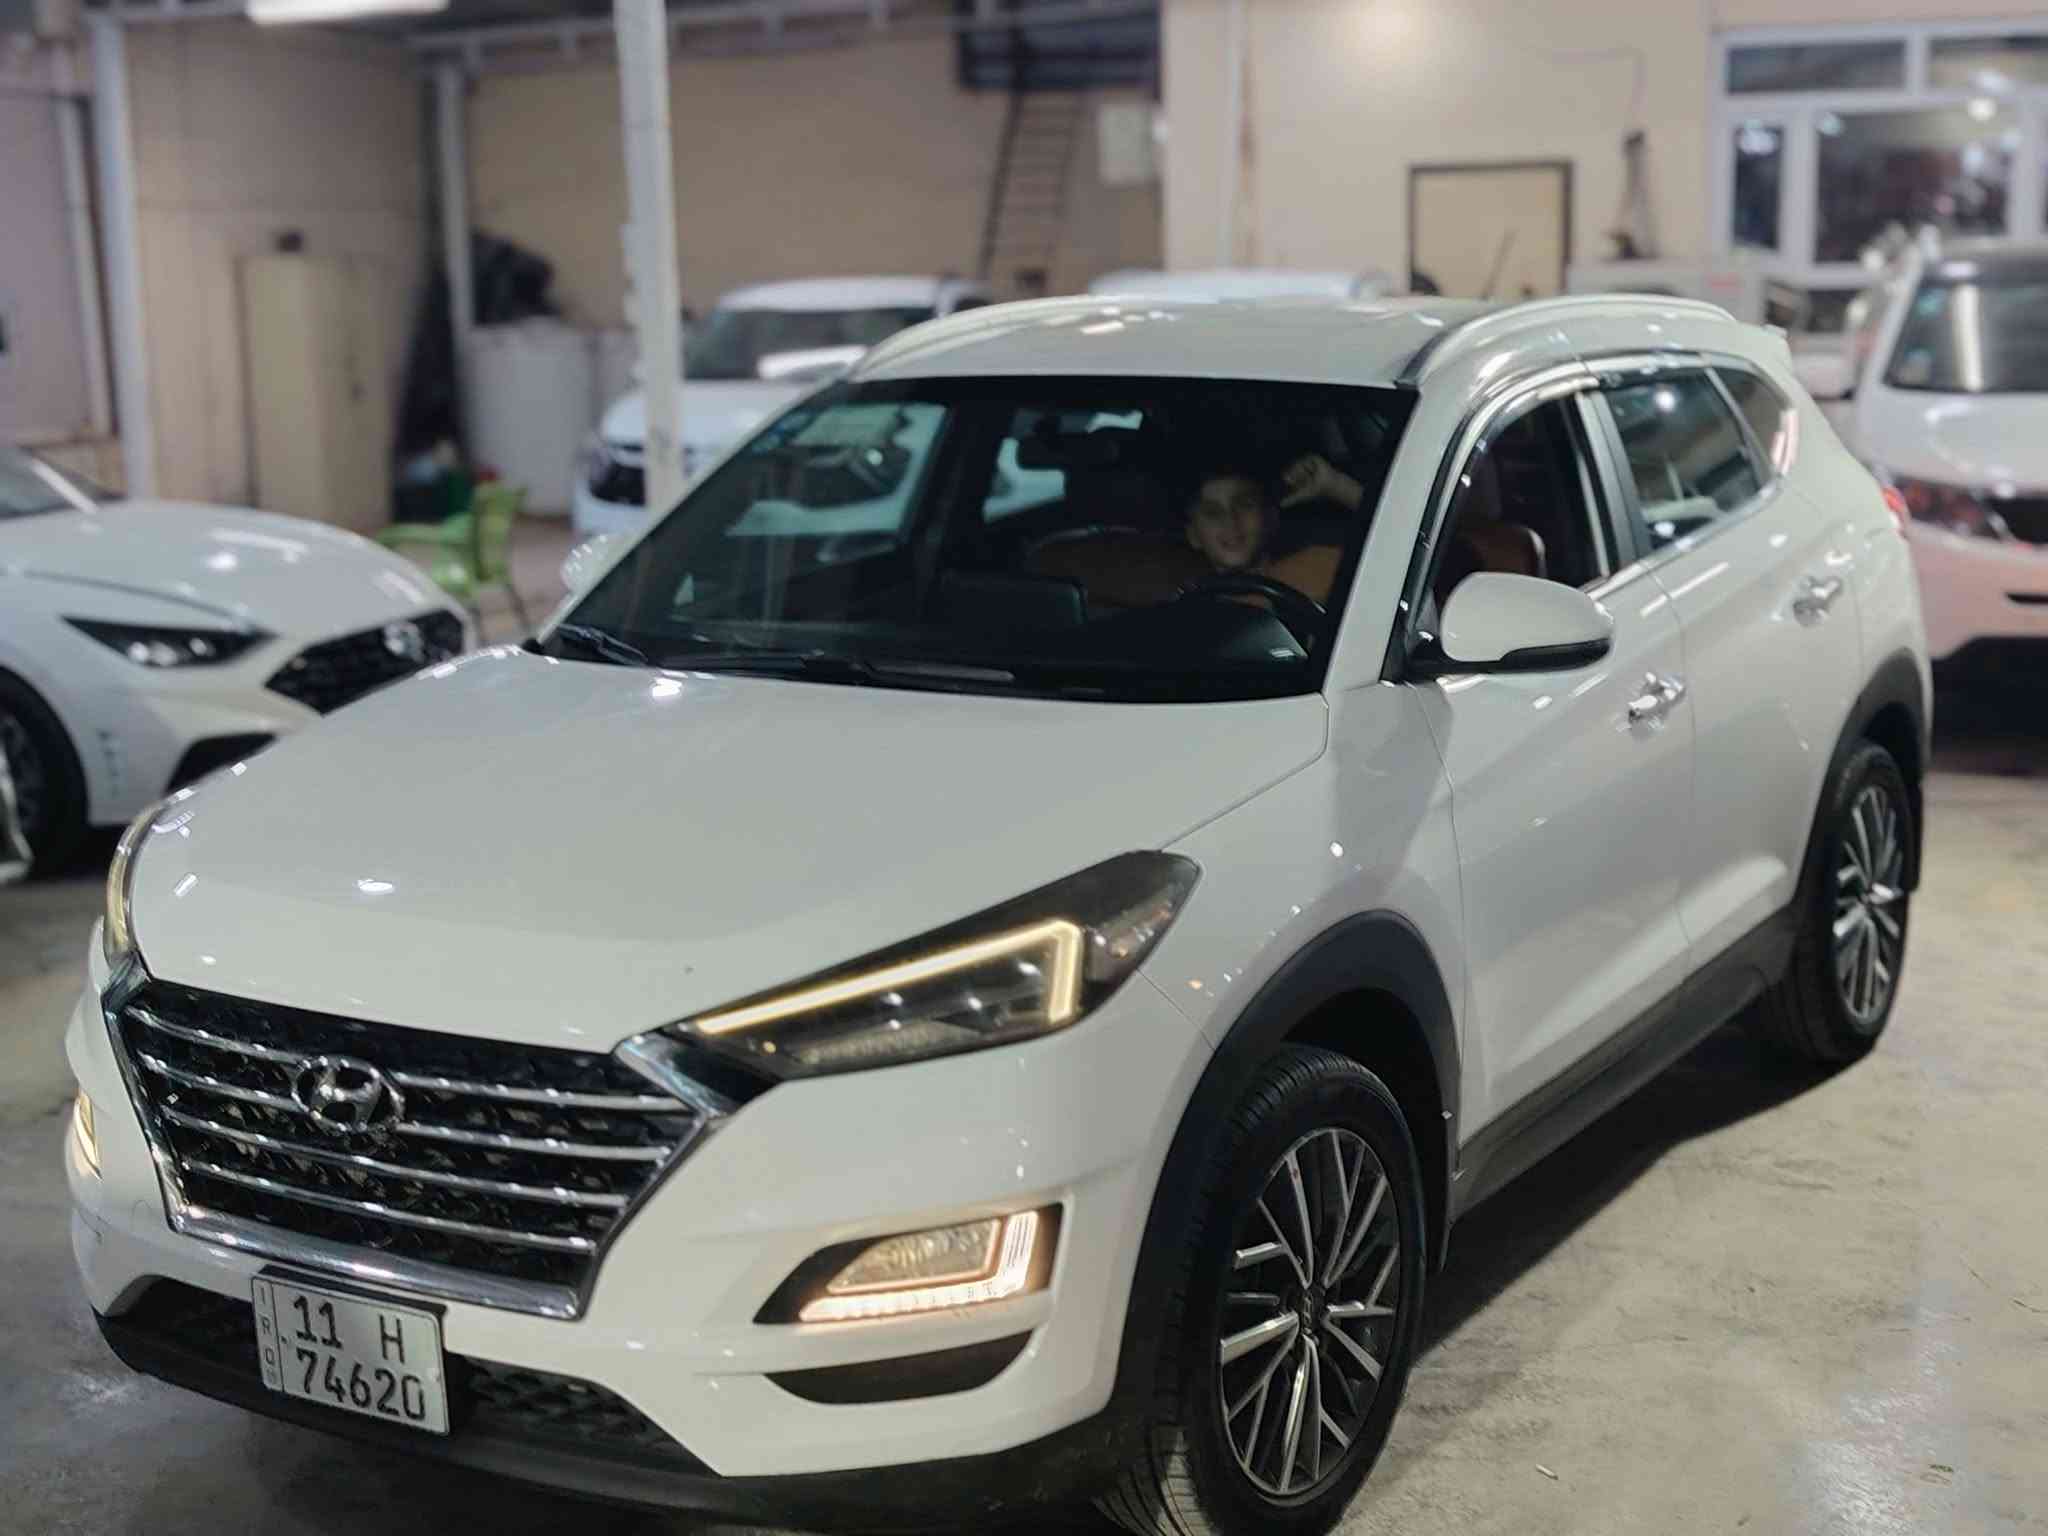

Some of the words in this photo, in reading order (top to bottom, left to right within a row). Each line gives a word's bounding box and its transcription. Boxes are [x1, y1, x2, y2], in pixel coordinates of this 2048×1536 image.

[294, 1296, 343, 1348] 11
[379, 1314, 405, 1363] H
[296, 1348, 425, 1420] 74620
